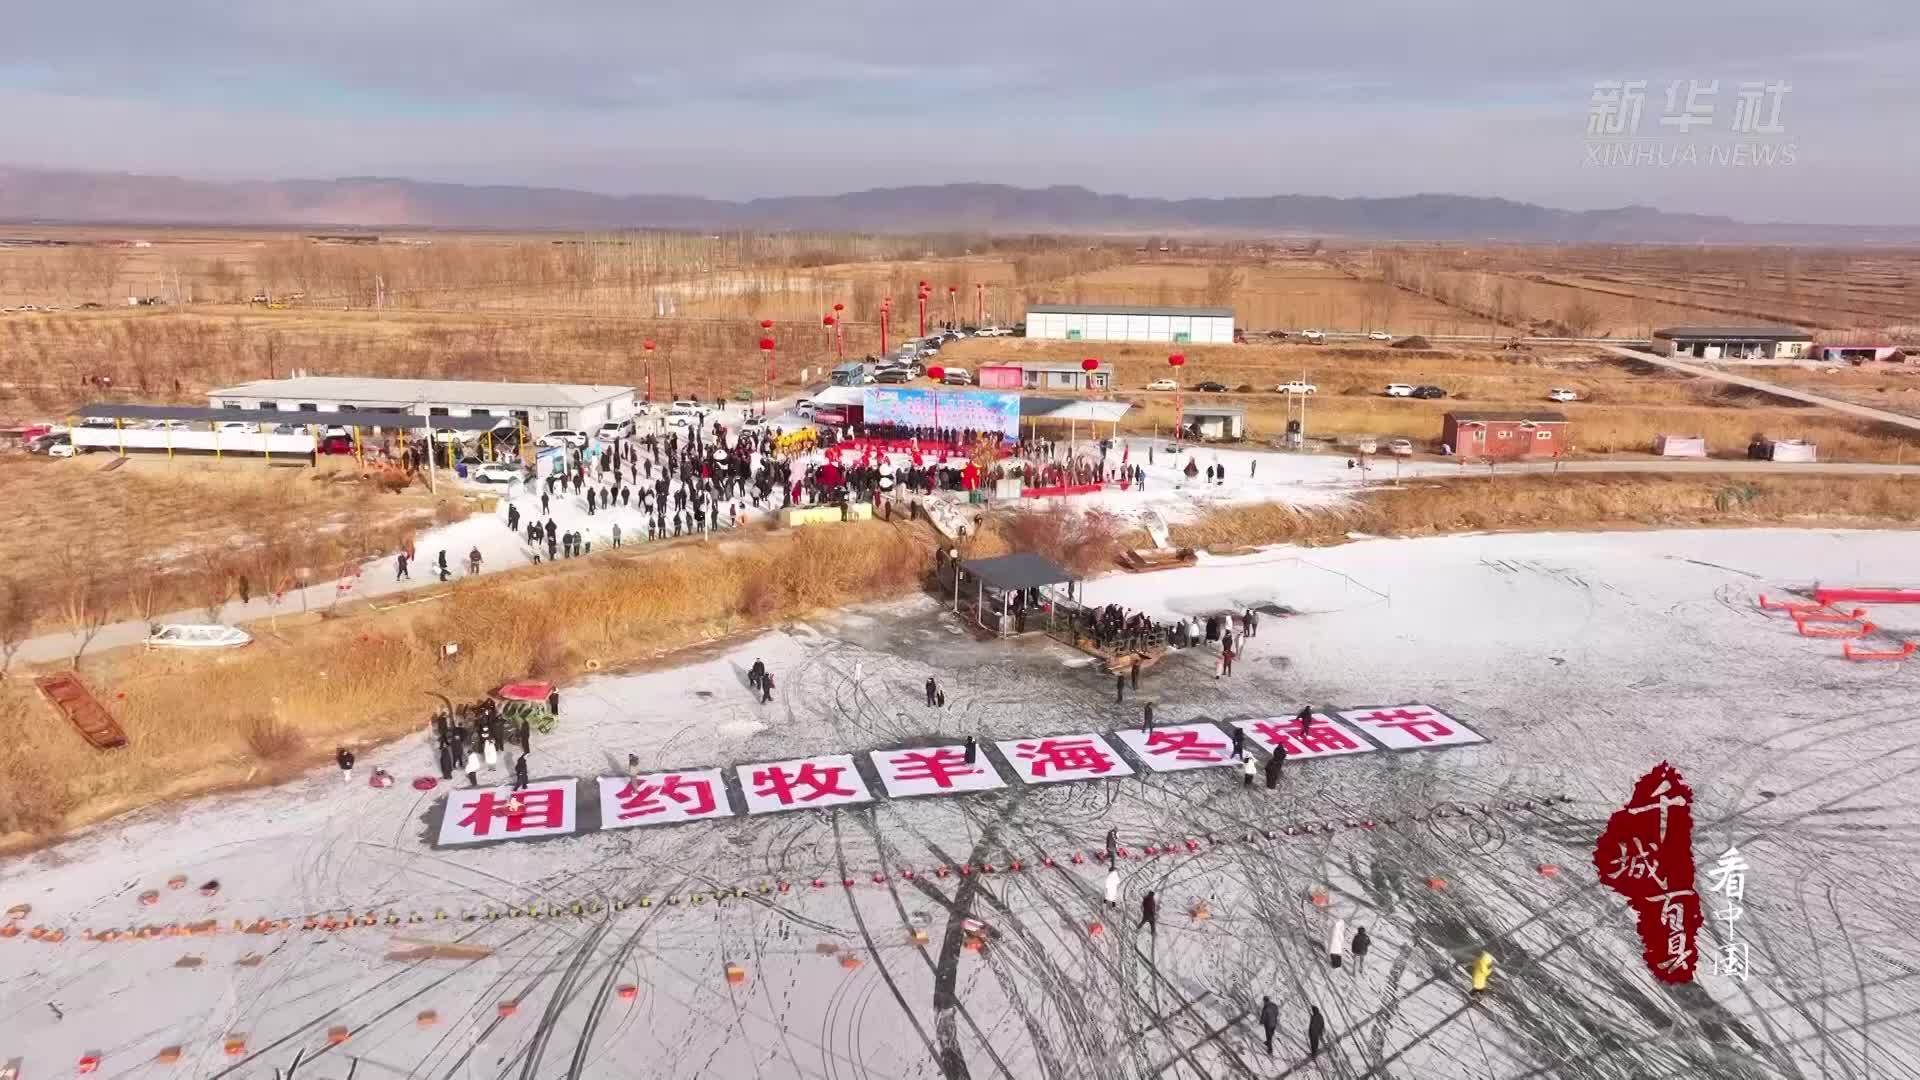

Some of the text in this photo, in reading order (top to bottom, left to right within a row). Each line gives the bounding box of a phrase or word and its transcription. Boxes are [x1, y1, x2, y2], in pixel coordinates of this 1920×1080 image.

[459, 704, 1457, 836] 相约牧羊海冬捕节
